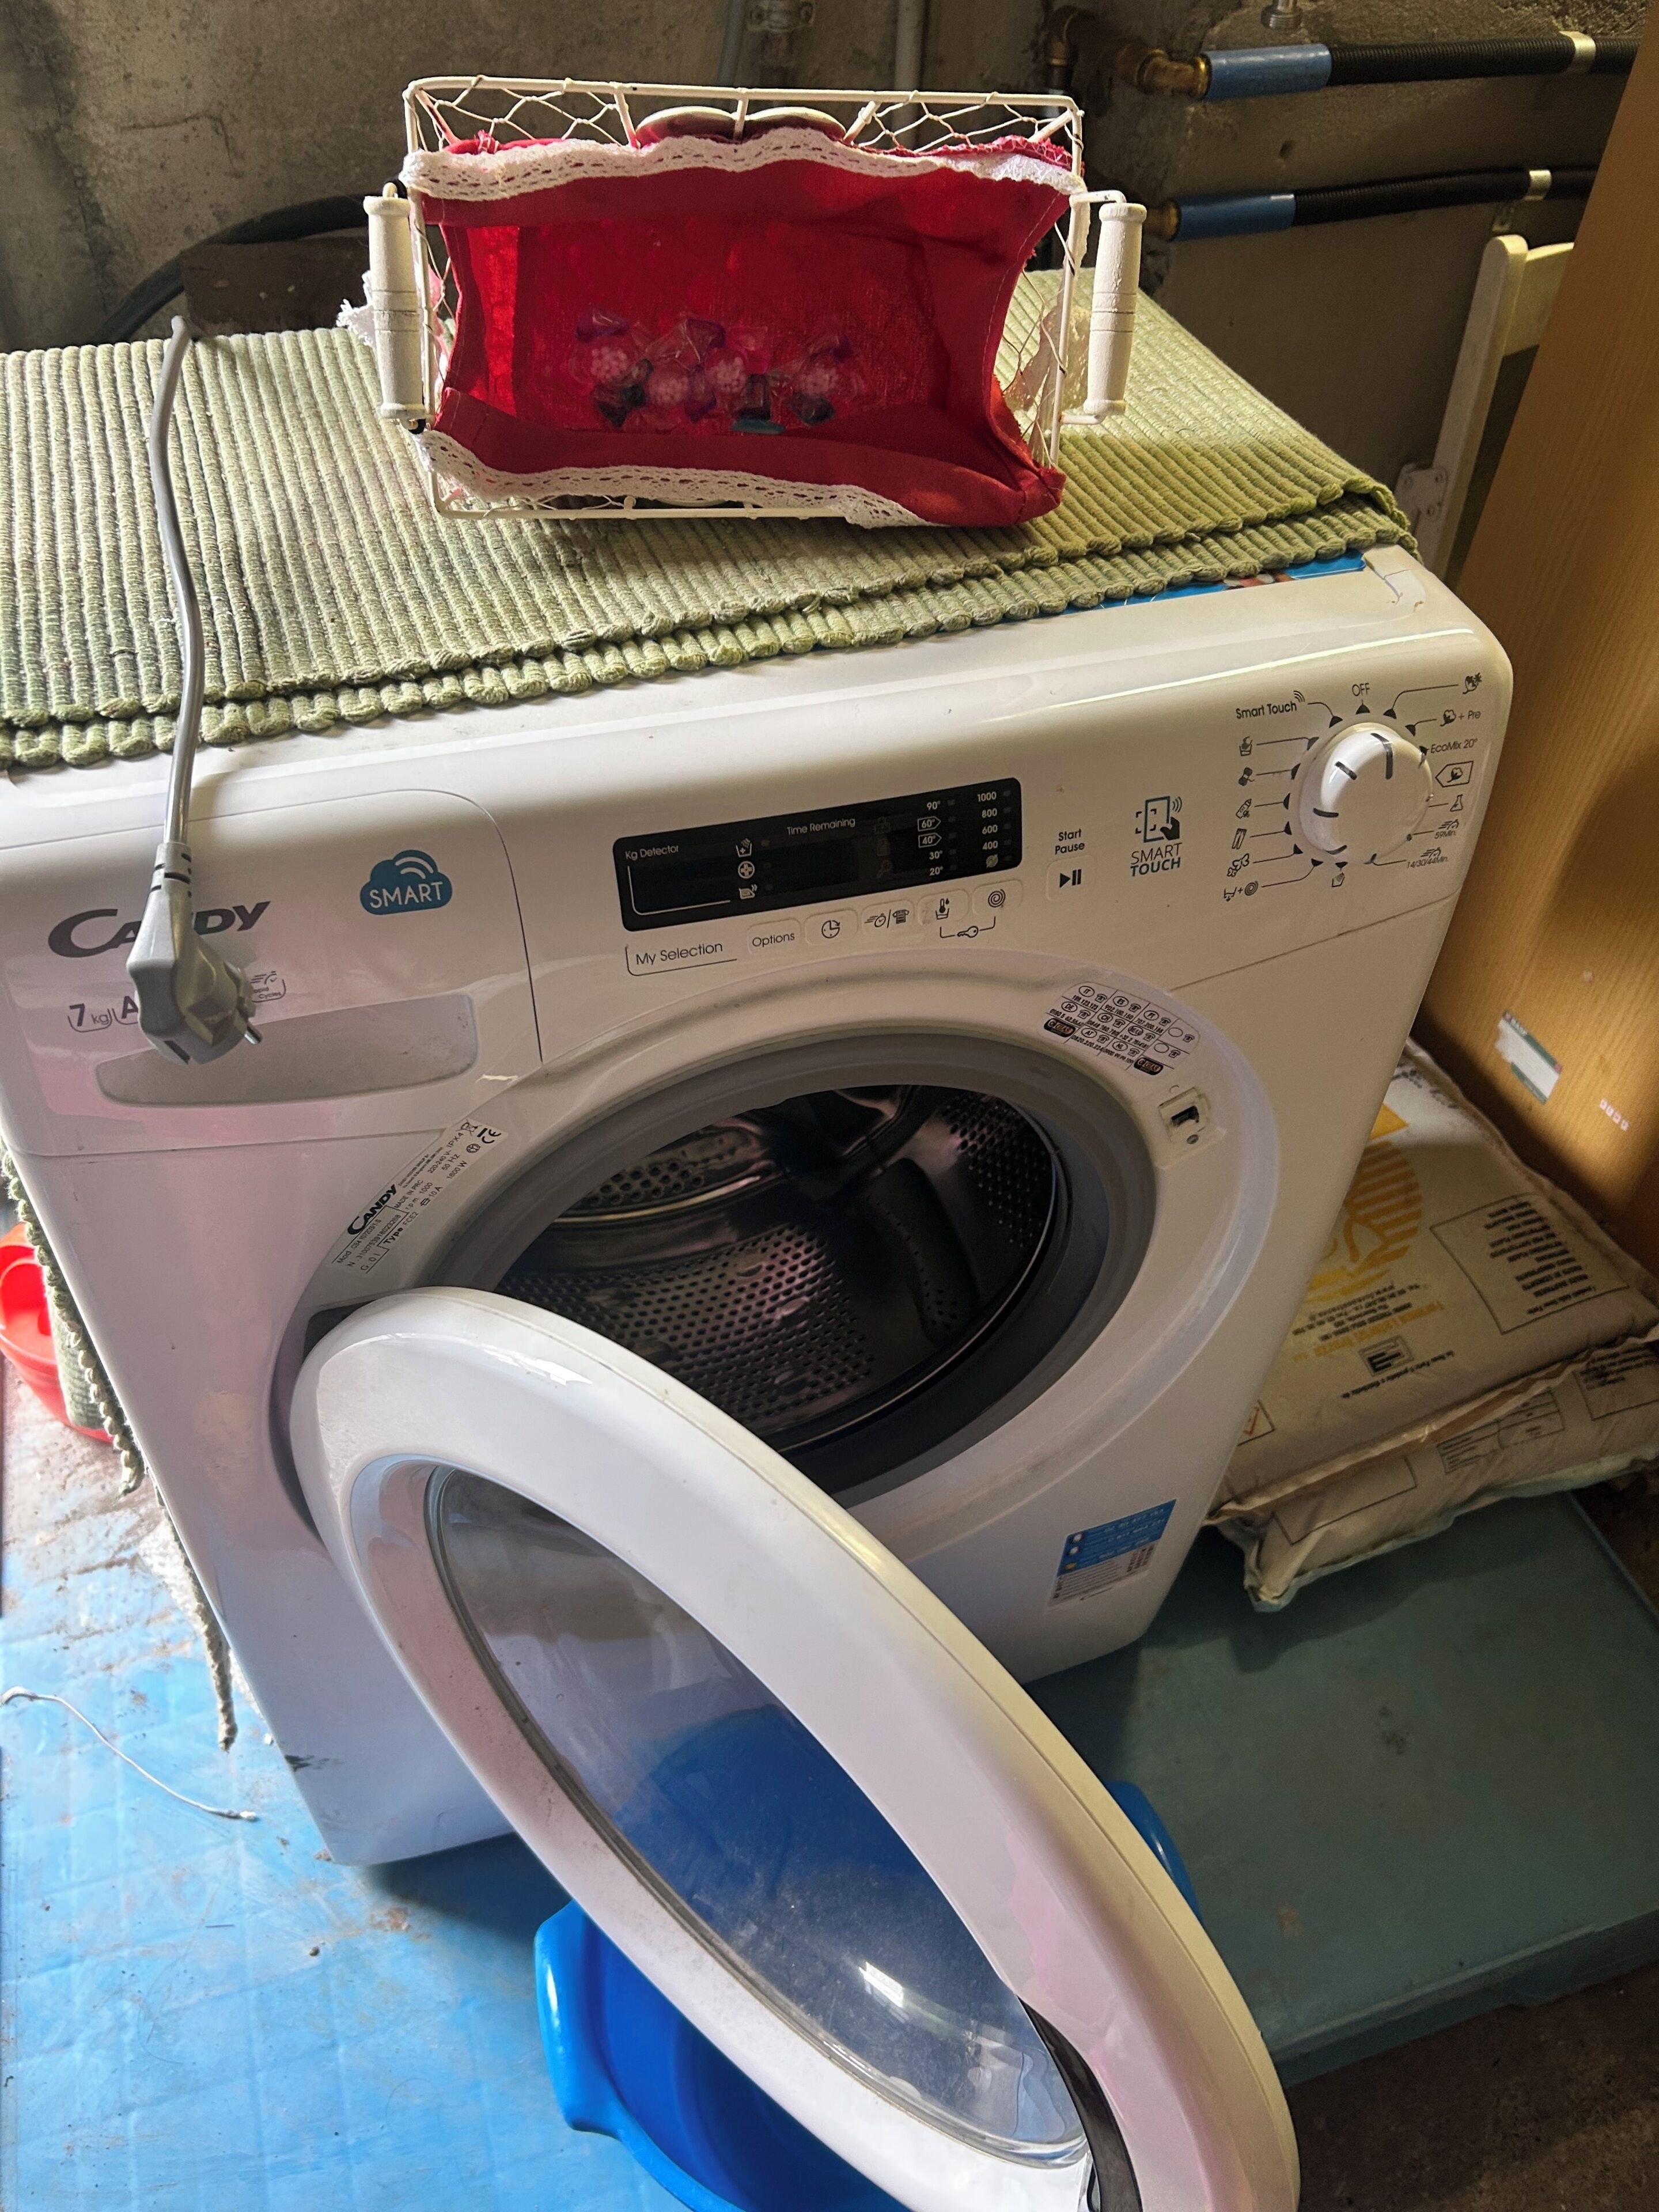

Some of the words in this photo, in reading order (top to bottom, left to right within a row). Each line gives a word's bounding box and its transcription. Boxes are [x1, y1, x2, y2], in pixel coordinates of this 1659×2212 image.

[1352, 683, 1370, 696] OFF
[1236, 705, 1264, 719] Smart
[1267, 700, 1297, 714] Touch
[1468, 711, 1482, 719] Pre
[1430, 741, 1461, 753] EcoMix
[978, 791, 997, 802] 1000
[982, 808, 997, 818] 800
[787, 826, 808, 835] Time
[810, 819, 855, 832] Remaining
[982, 825, 998, 835] 600
[1059, 828, 1081, 841] Start
[982, 840, 998, 850] 400
[1055, 843, 1085, 854] Pause
[626, 851, 638, 861] Kg
[640, 845, 679, 858] Detector
[1131, 842, 1183, 865] SMART
[1130, 857, 1180, 877] TOUCH
[369, 881, 442, 908] SMART
[48, 901, 271, 958] CADY
[752, 933, 795, 947] Options
[636, 953, 656, 967] My
[660, 943, 723, 961] Selection
[259, 991, 281, 1000] Cycles
[69, 1003, 86, 1027] 7
[91, 1013, 109, 1025] kg
[428, 1156, 446, 1173] 220-240
[447, 1132, 464, 1148] IPX4
[448, 1154, 460, 1162] Hz
[394, 1196, 408, 1209] MADE
[412, 1180, 423, 1190] PRC
[419, 1182, 433, 1194] 1000
[347, 1184, 396, 1235] CANDY
[384, 1228, 403, 1244] Type
[403, 1211, 419, 1226] FCE2
